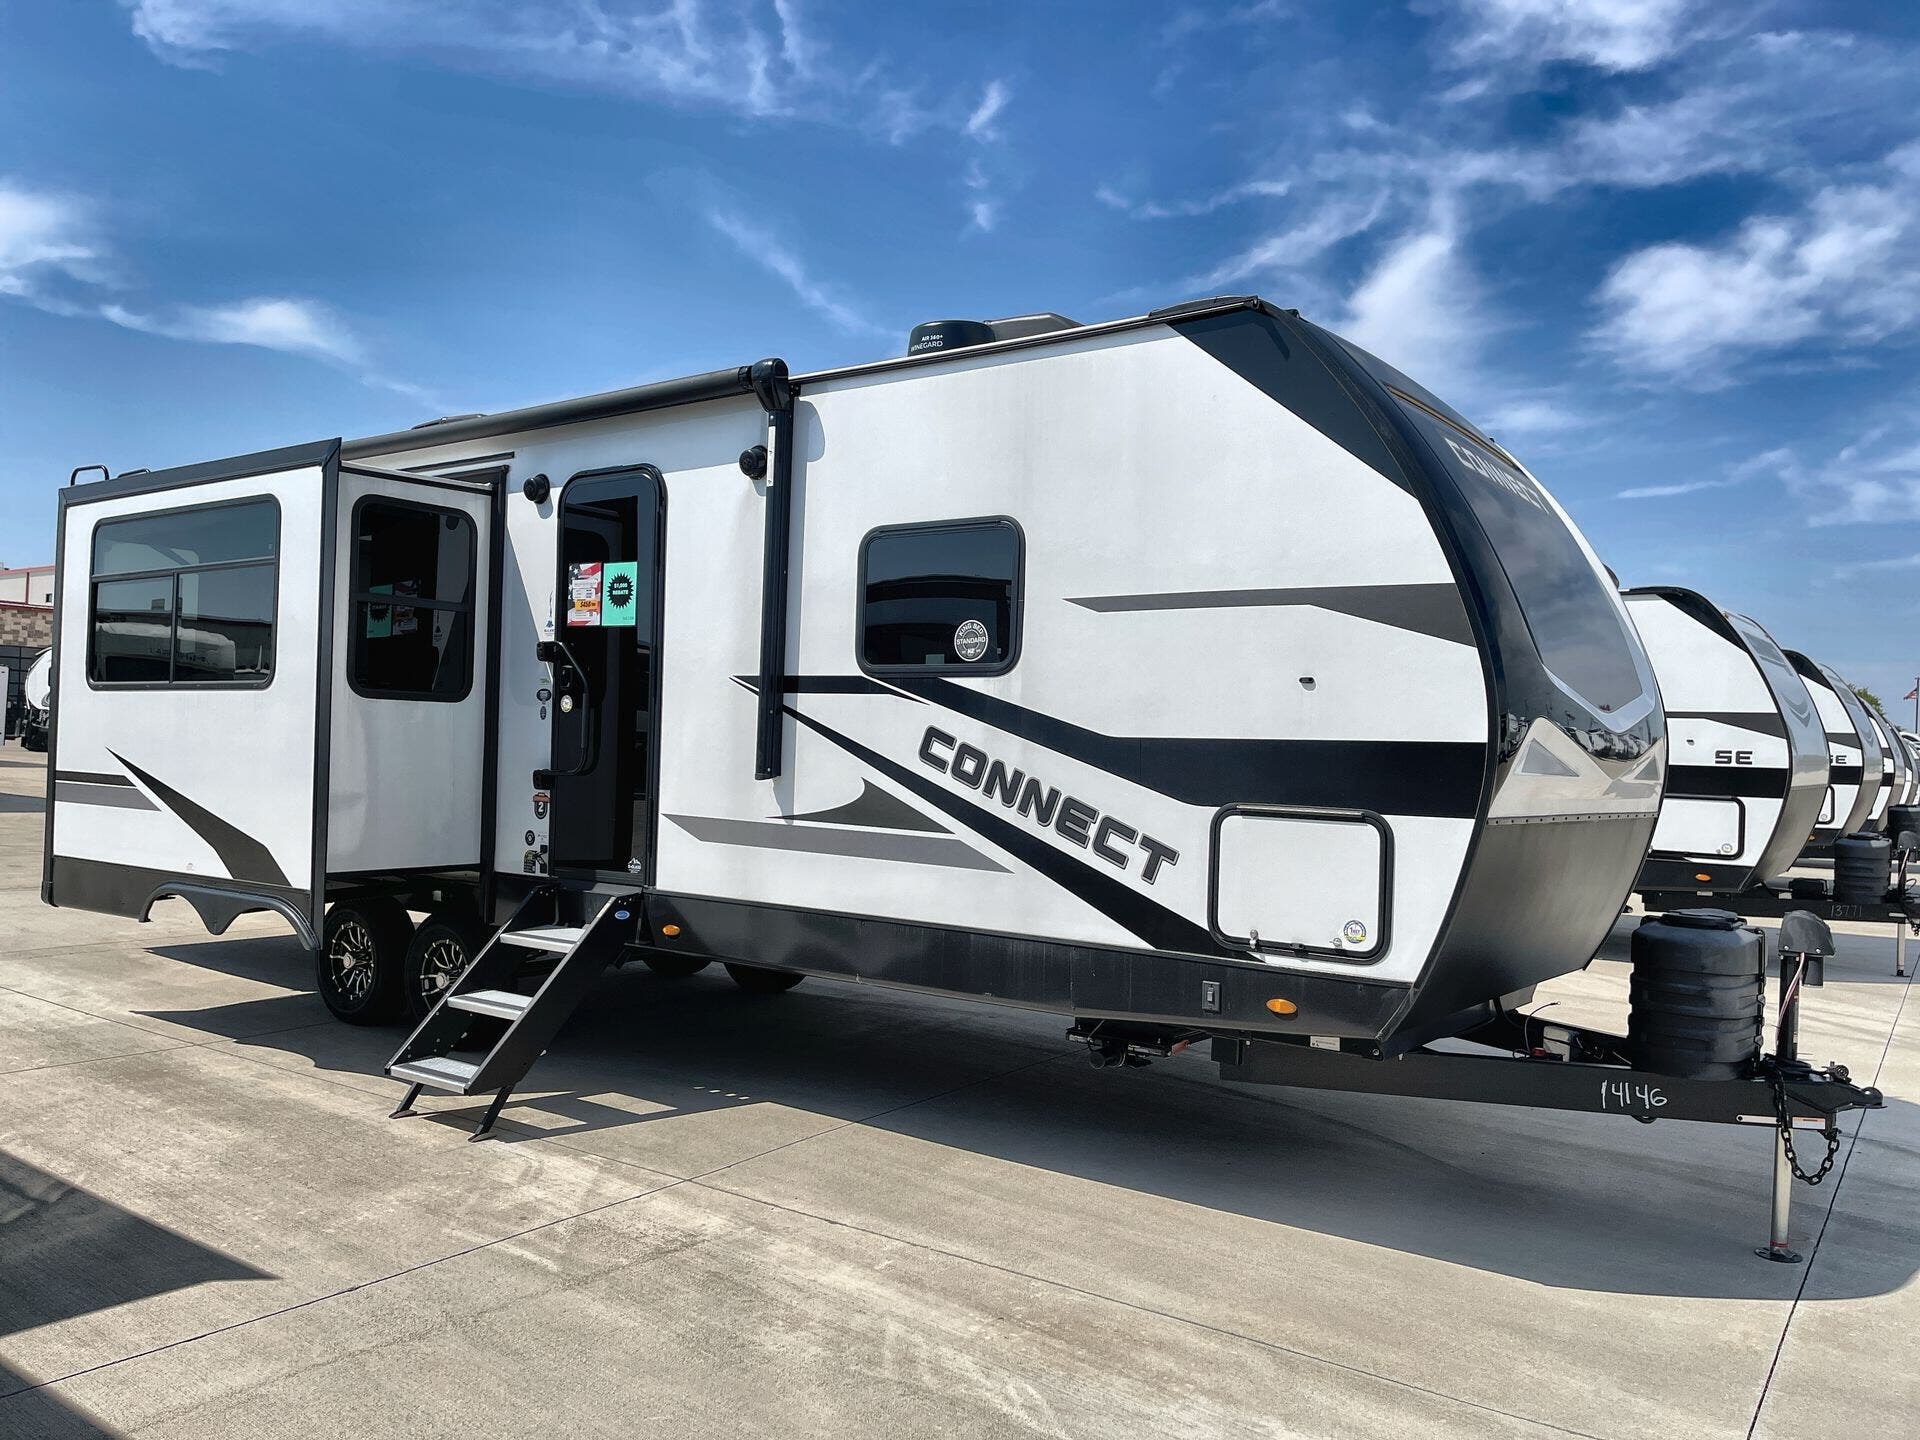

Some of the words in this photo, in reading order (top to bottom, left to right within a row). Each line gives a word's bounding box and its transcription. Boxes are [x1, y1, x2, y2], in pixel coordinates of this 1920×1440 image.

[910, 340, 944, 352] WINEGARD
[1444, 437, 1550, 515] CONNECT
[958, 622, 972, 637] KING
[972, 623, 984, 635] BED
[956, 636, 986, 645] STANDARD
[1714, 750, 1753, 765] SE
[538, 801, 544, 812] 2
[918, 724, 1180, 885] CONNECT
[1601, 1080, 1668, 1110] 14146
